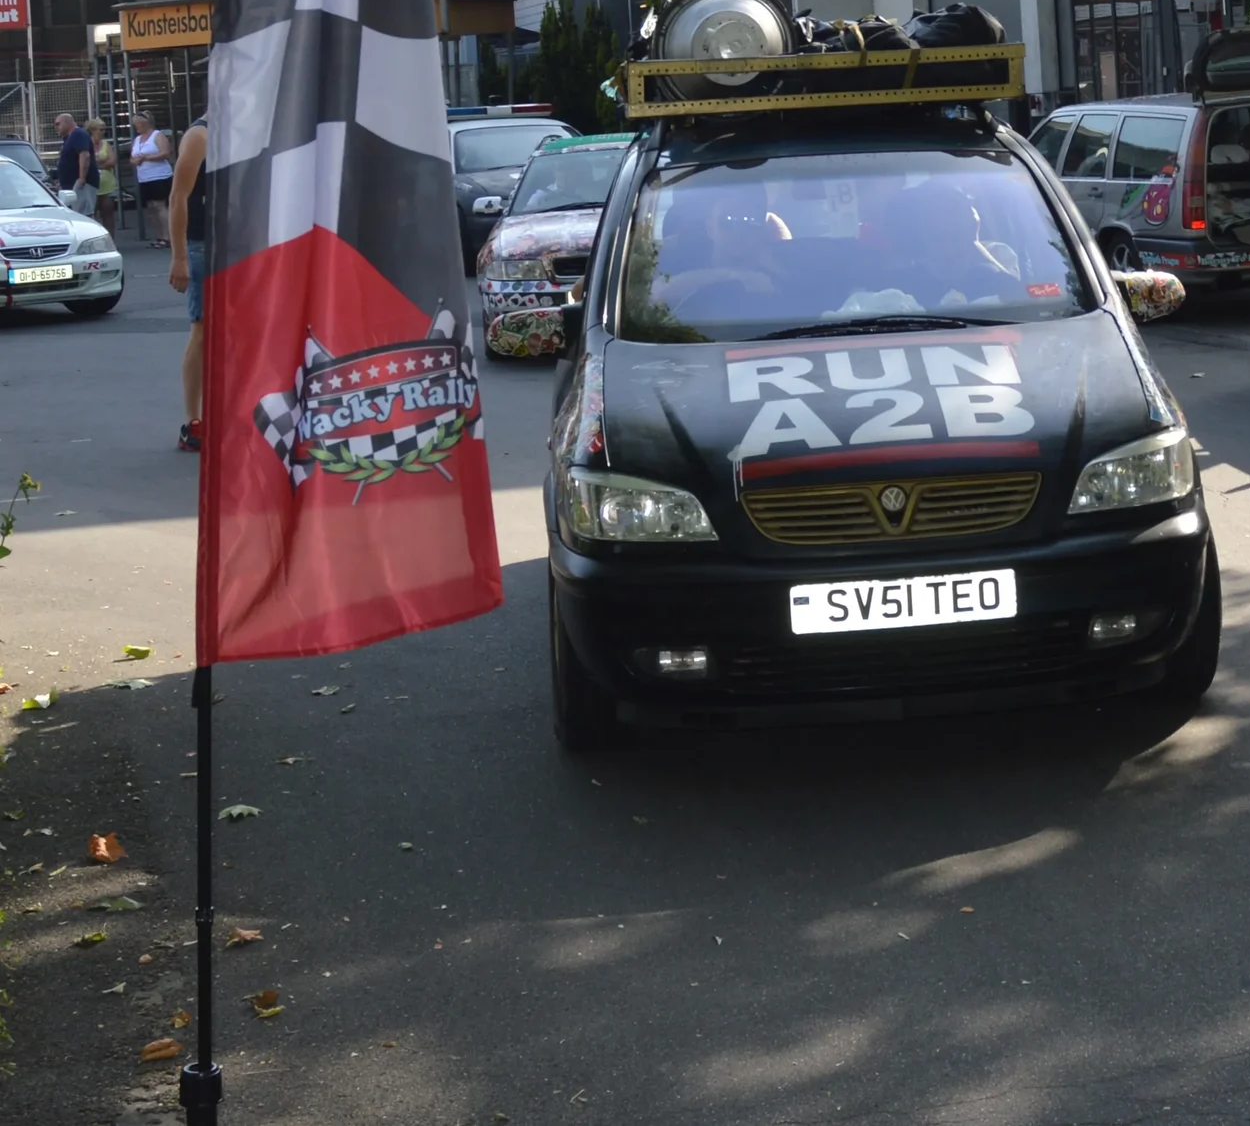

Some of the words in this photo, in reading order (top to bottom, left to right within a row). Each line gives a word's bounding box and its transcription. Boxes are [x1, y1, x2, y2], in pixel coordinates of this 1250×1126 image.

[400, 377, 477, 411] Rally
[727, 344, 1022, 404] RUN
[730, 385, 1035, 459] A2B
[827, 584, 913, 622] SV51
